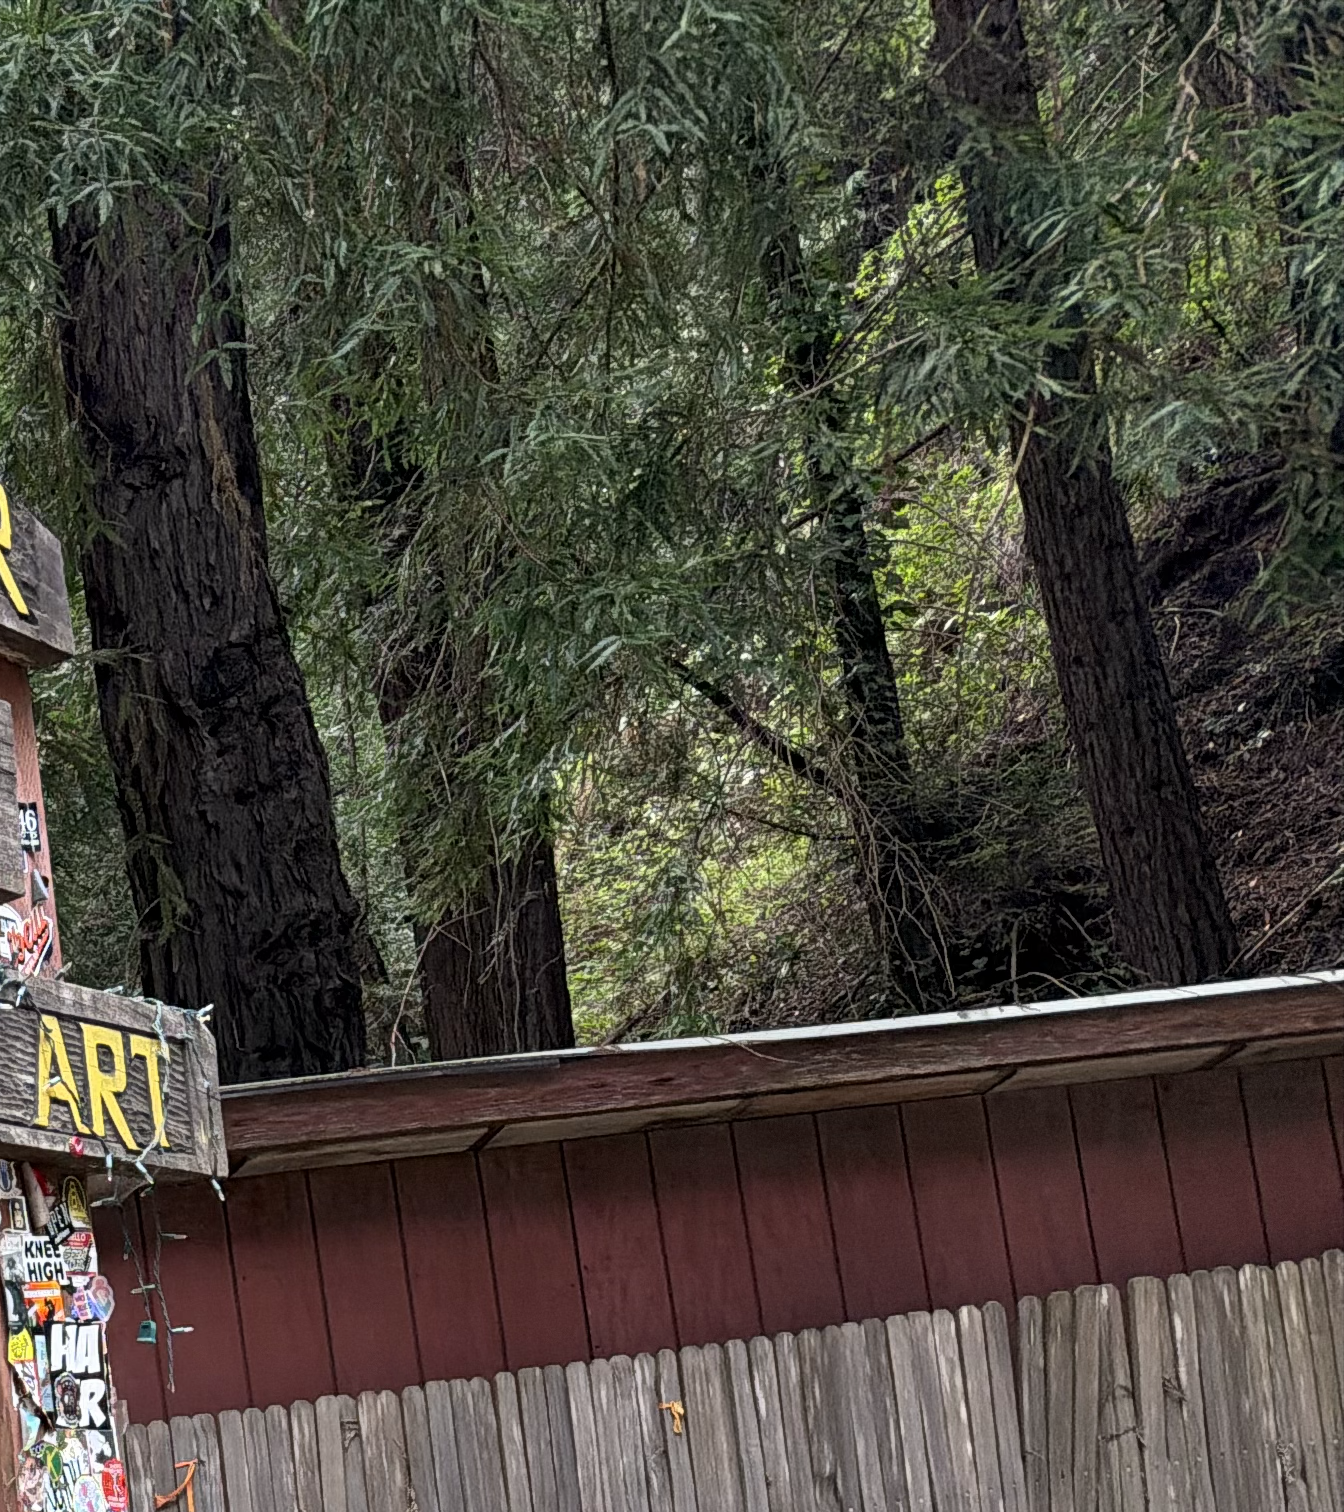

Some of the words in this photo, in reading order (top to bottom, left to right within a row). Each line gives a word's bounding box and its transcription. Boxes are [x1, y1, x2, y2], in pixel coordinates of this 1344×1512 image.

[35, 1014, 169, 1150] ART
[25, 1240, 61, 1258] KNEE
[27, 1261, 64, 1282] HIGH
[51, 1323, 101, 1374] HA
